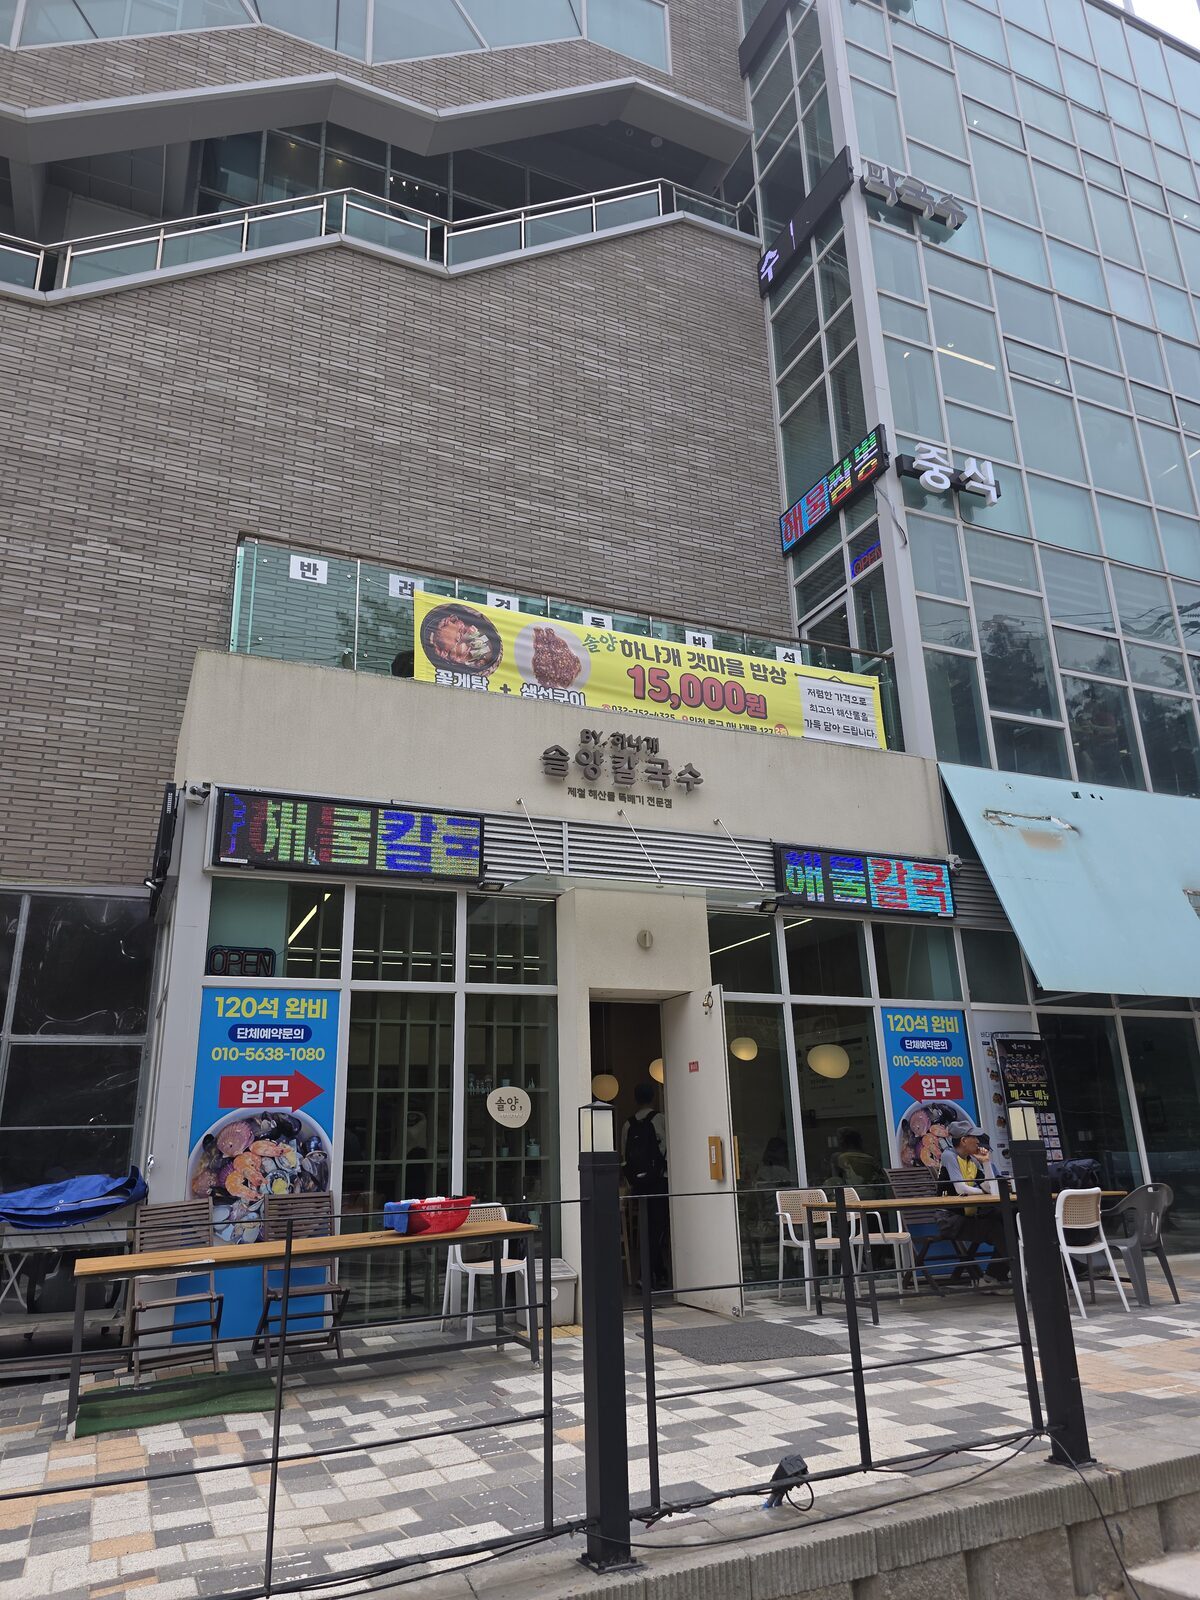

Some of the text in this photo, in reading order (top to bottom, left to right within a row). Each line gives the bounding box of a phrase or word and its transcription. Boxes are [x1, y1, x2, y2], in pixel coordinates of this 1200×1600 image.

[913, 442, 997, 507] 중식
[299, 561, 319, 581] 반
[582, 632, 787, 685] 솔양 하나개 갯마을 밥상
[627, 664, 768, 720] 15,000원
[807, 688, 867, 706] 저렴한 가격으로
[809, 703, 869, 722] 최고의 해산물을
[804, 718, 878, 739] 가득 담아 드립니다.
[610, 731, 660, 755] 하나개
[567, 787, 586, 799] 제철
[588, 789, 616, 802] 해산물
[211, 950, 273, 976] OPEN
[214, 996, 328, 1020] 120석 완비
[236, 1027, 305, 1040] 단체예약문의
[887, 1014, 960, 1034] 120석 완비
[211, 1047, 326, 1062] 010-5638-1080
[904, 1039, 948, 1050] 단체예약문의
[892, 1055, 964, 1068] 010-5638-1080
[241, 1079, 290, 1105] 입구
[921, 1078, 951, 1097] 입구
